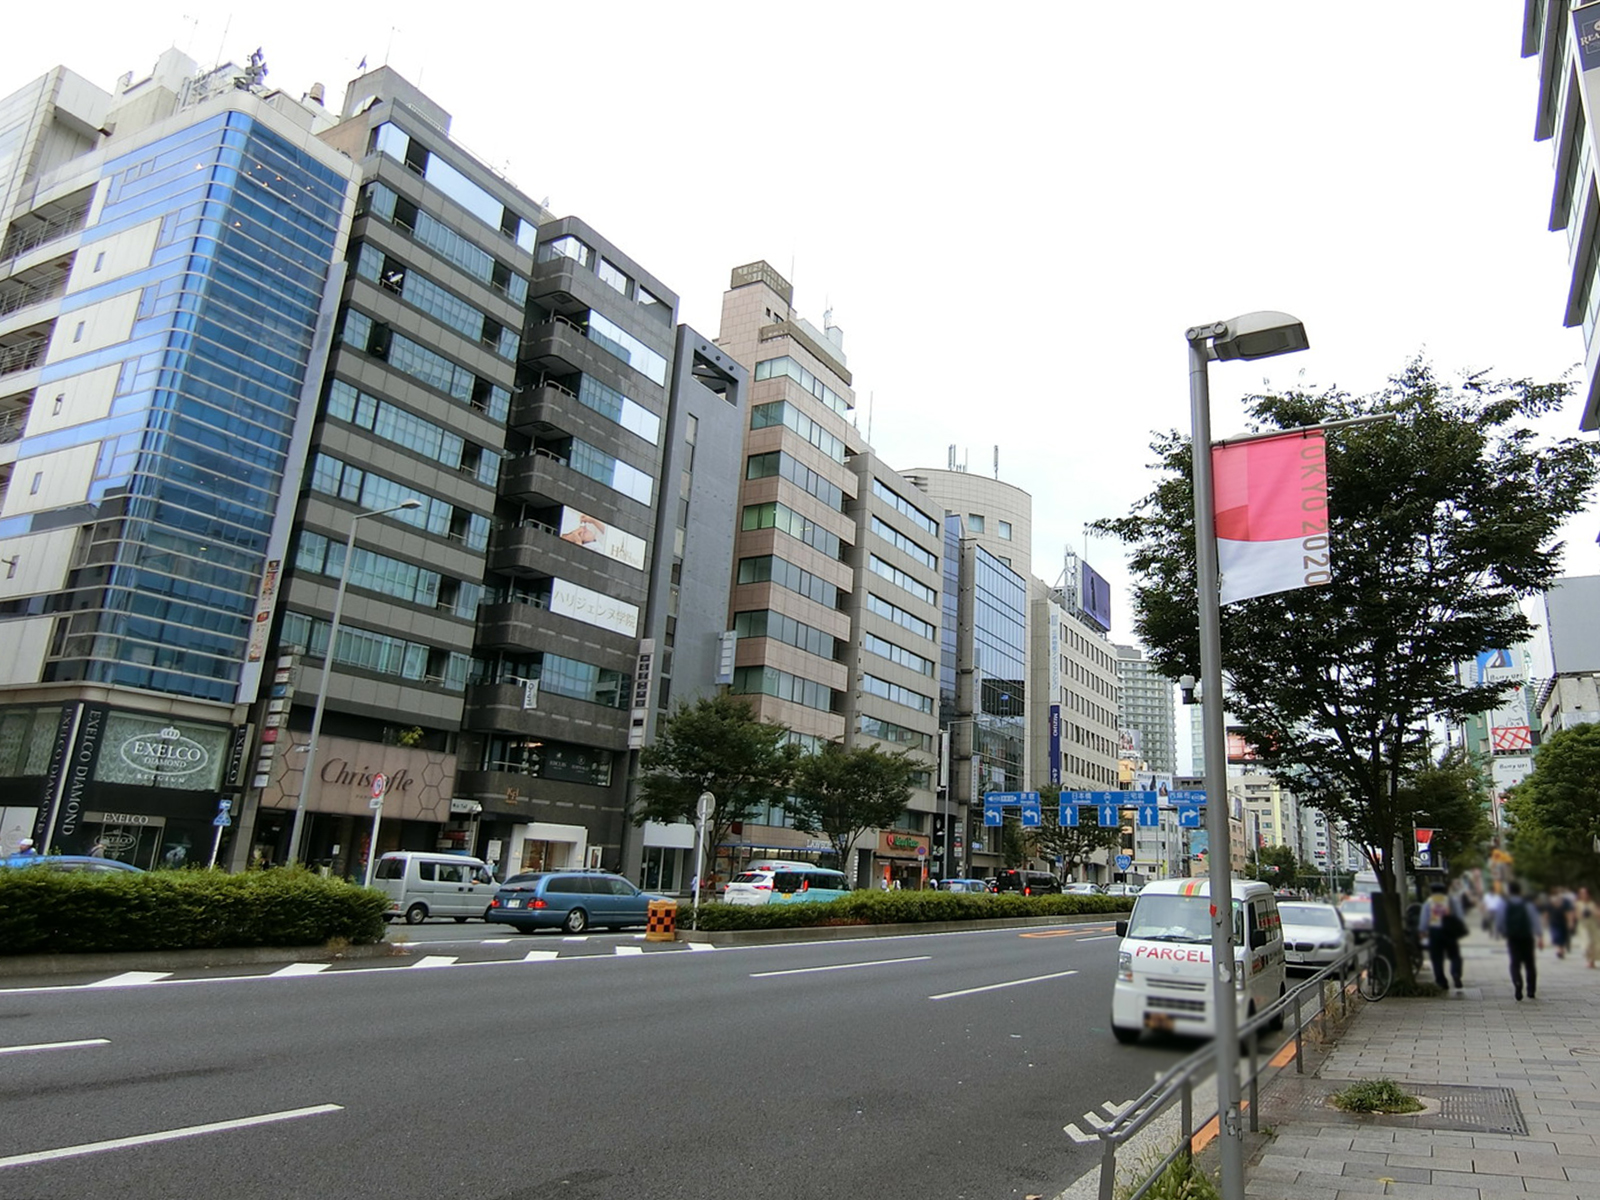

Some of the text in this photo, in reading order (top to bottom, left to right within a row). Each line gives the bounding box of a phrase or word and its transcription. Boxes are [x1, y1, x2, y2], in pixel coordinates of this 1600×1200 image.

[1301, 436, 1331, 586] OKYO 2020
[133, 741, 201, 762] EXELCO
[230, 729, 247, 781] EXELCO
[62, 710, 102, 836] EXELCO DIAMOND
[143, 757, 187, 768] DIAMOND
[103, 812, 149, 825] EXELCO
[1136, 946, 1210, 963] PARCEL
